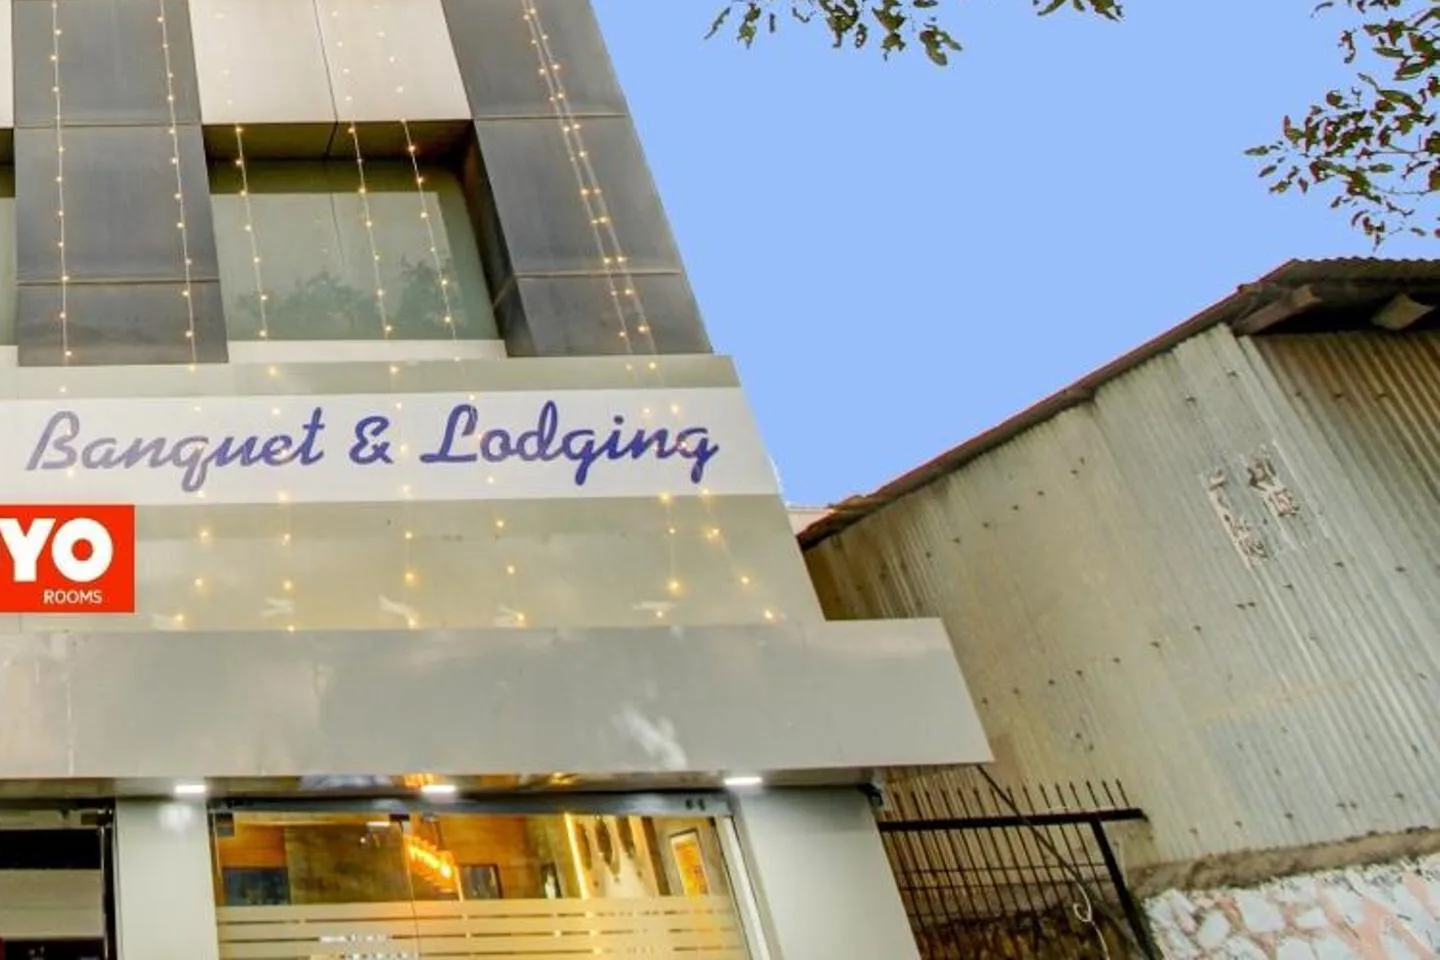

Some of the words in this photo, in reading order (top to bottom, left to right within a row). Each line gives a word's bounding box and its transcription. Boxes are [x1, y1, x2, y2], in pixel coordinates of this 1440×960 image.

[26, 406, 326, 492] Banquet
[348, 415, 394, 465] &
[419, 400, 720, 486] Lodging
[42, 589, 104, 605] ROOMS
